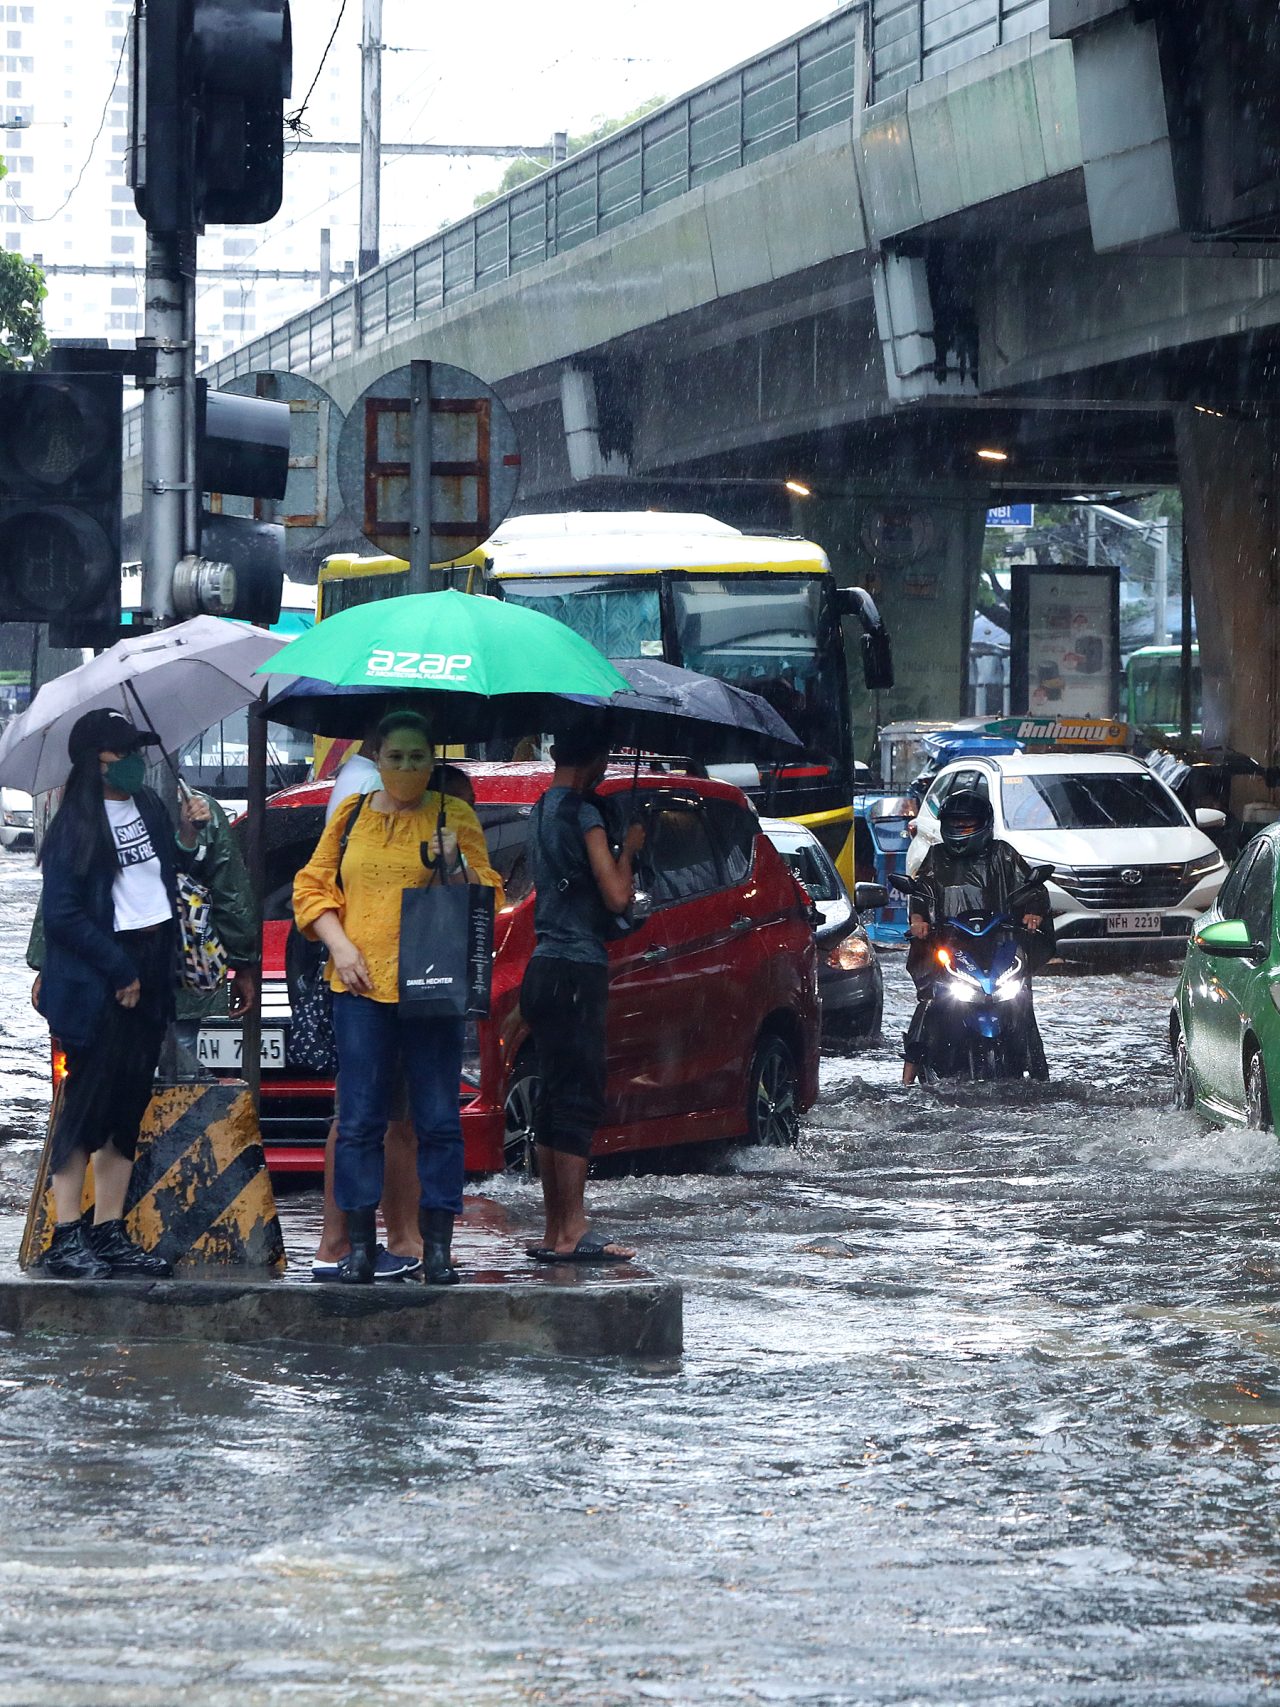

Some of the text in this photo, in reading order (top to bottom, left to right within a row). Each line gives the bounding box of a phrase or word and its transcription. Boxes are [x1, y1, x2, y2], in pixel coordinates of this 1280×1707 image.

[989, 506, 1010, 517] NBI
[1017, 722, 1109, 740] Anthony
[1109, 917, 1160, 928] NFH 2219
[426, 977, 453, 985] HECHTER
[233, 1039, 280, 1059] 745
